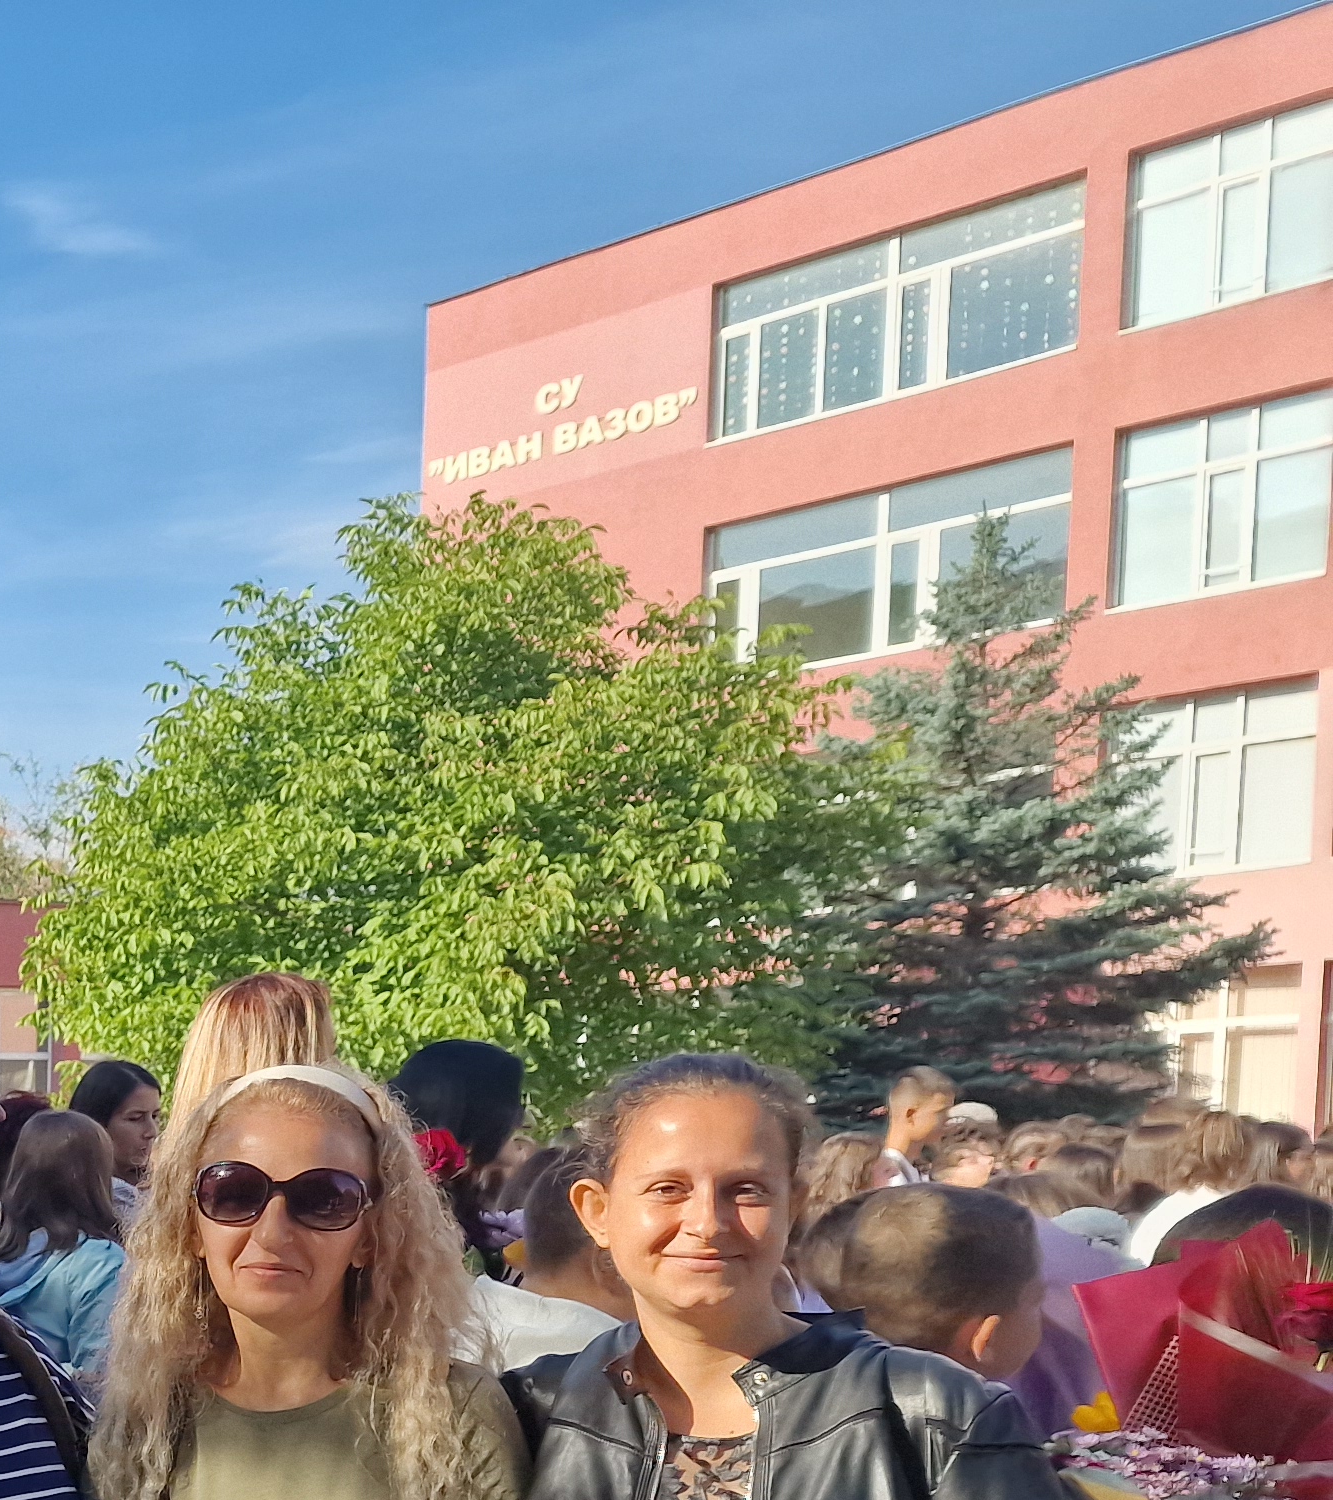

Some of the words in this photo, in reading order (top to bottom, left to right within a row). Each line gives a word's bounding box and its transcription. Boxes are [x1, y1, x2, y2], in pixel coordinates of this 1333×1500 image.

[534, 373, 584, 415] СУ
[428, 430, 543, 485] "ИВАН
[552, 386, 699, 455] ВАЗОВ"
